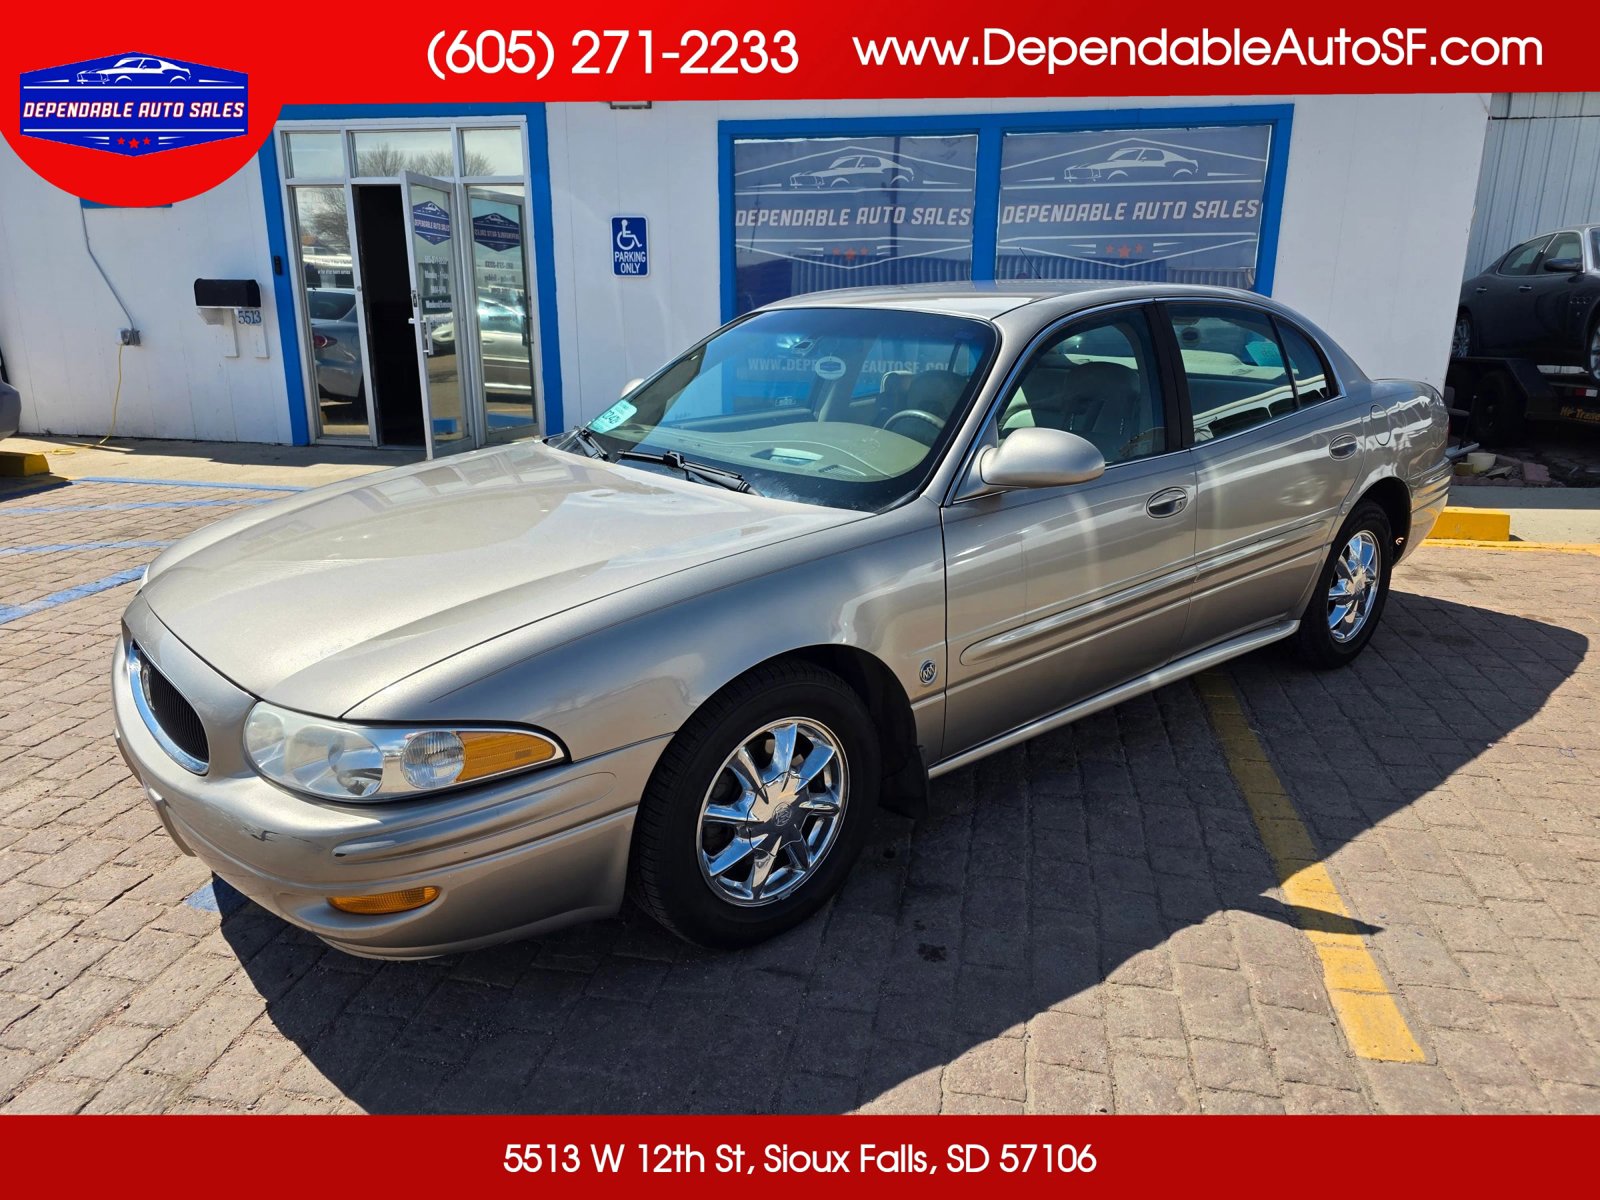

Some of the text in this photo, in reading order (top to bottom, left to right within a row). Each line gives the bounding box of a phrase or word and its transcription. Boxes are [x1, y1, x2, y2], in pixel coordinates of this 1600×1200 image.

[735, 206, 971, 227] DEPENDABLE AUTO SALES
[1001, 199, 1260, 224] DEPENDABLE AUTO SALES
[614, 251, 646, 263] PARKING
[620, 262, 641, 274] ONLY
[238, 310, 262, 325] 5513
